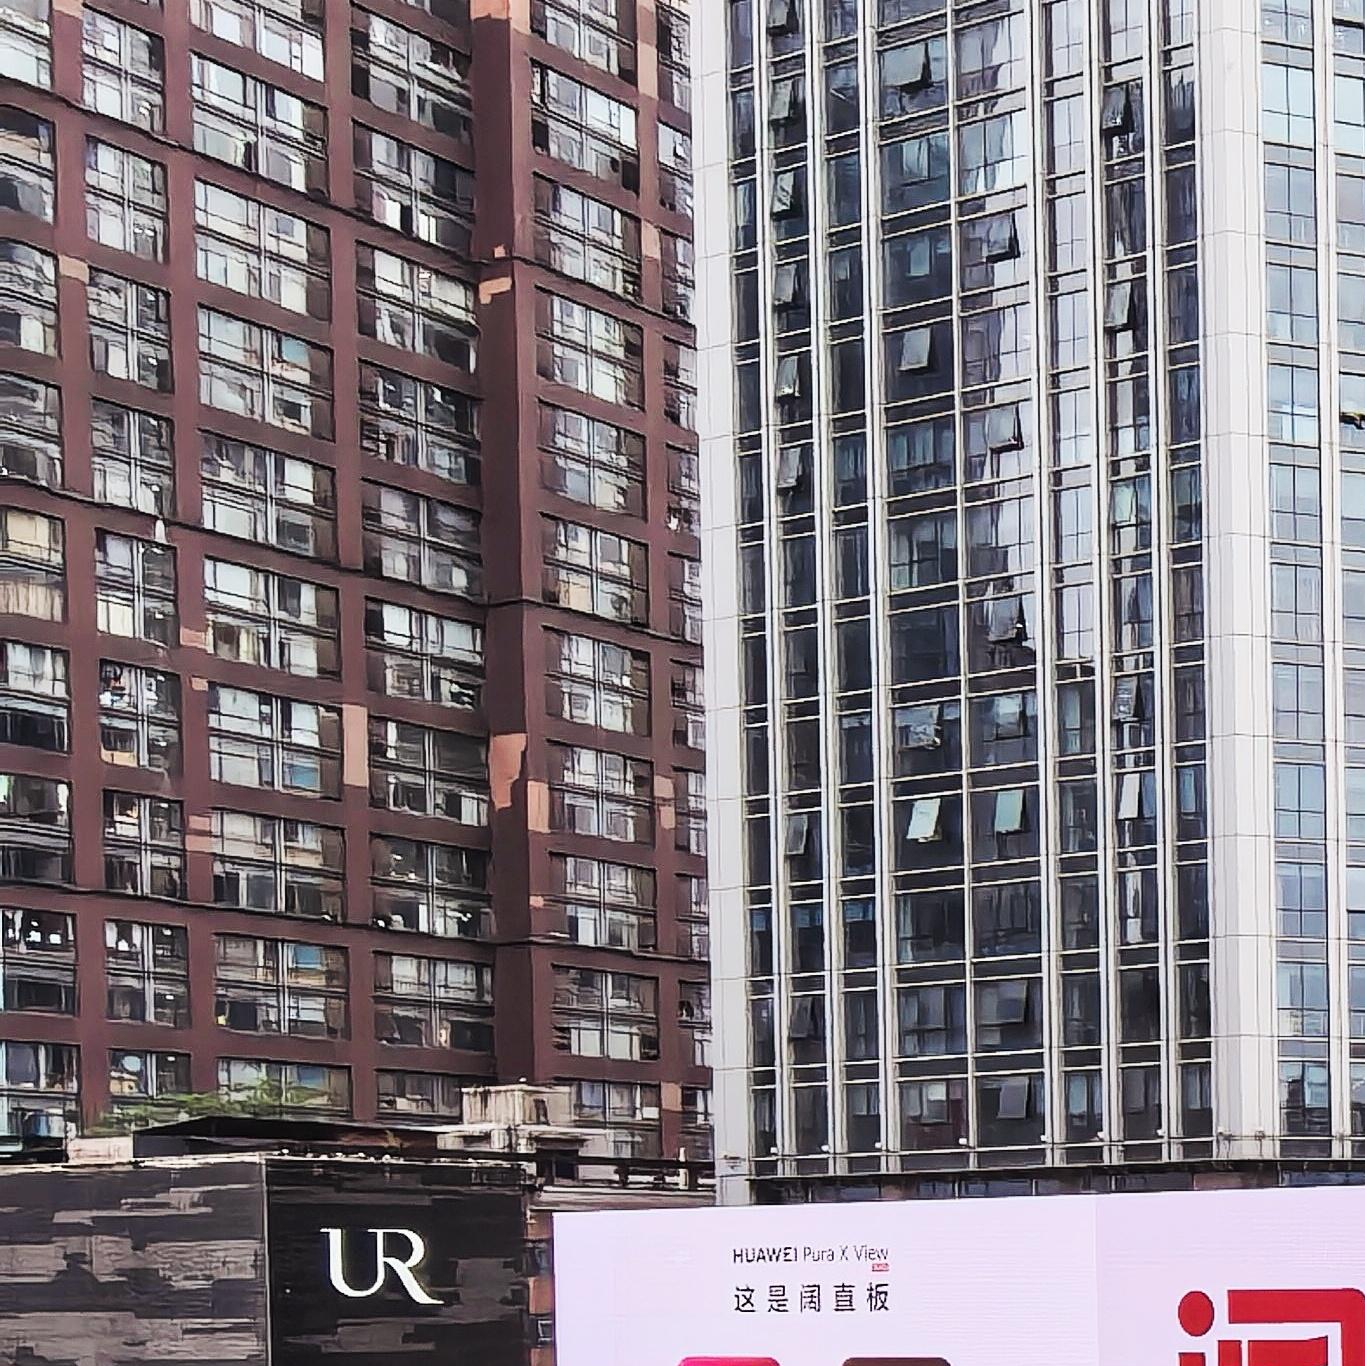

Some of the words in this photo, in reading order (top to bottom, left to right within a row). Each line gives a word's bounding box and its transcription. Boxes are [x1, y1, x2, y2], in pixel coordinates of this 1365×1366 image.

[320, 1228, 445, 1304] UR
[733, 1247, 797, 1263] HUAWEI
[803, 1246, 835, 1262] Pura
[839, 1246, 849, 1261] X
[853, 1246, 889, 1262] View
[734, 1283, 889, 1313] 这是阔直板
